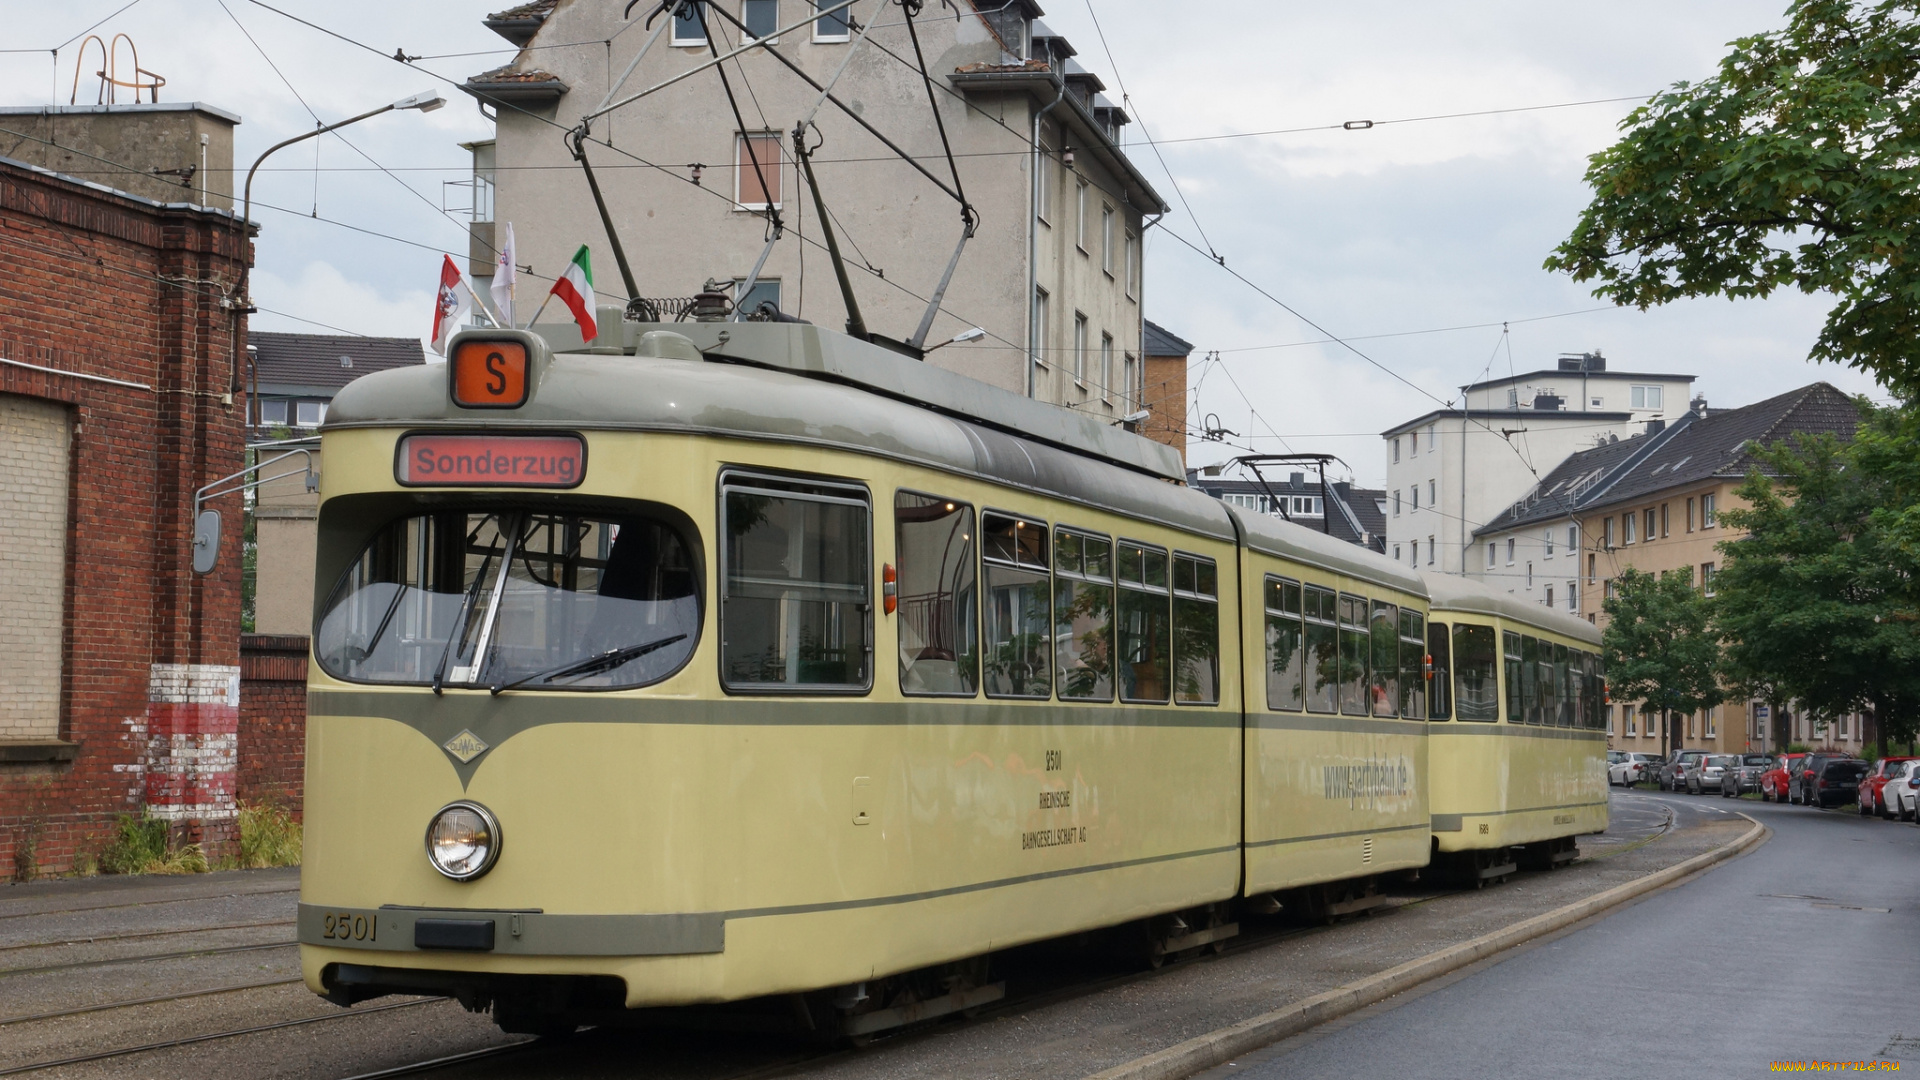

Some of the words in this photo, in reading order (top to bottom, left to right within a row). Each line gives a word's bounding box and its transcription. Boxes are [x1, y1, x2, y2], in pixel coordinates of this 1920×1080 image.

[486, 352, 506, 395] S
[416, 448, 575, 482] Sonderzug
[1046, 750, 1062, 771] 2501
[1323, 752, 1407, 811] www.partybahn.de
[1022, 827, 1077, 850] BAHNGESELLSCHAFT
[1079, 827, 1087, 843] AG
[323, 912, 377, 941] 2501
